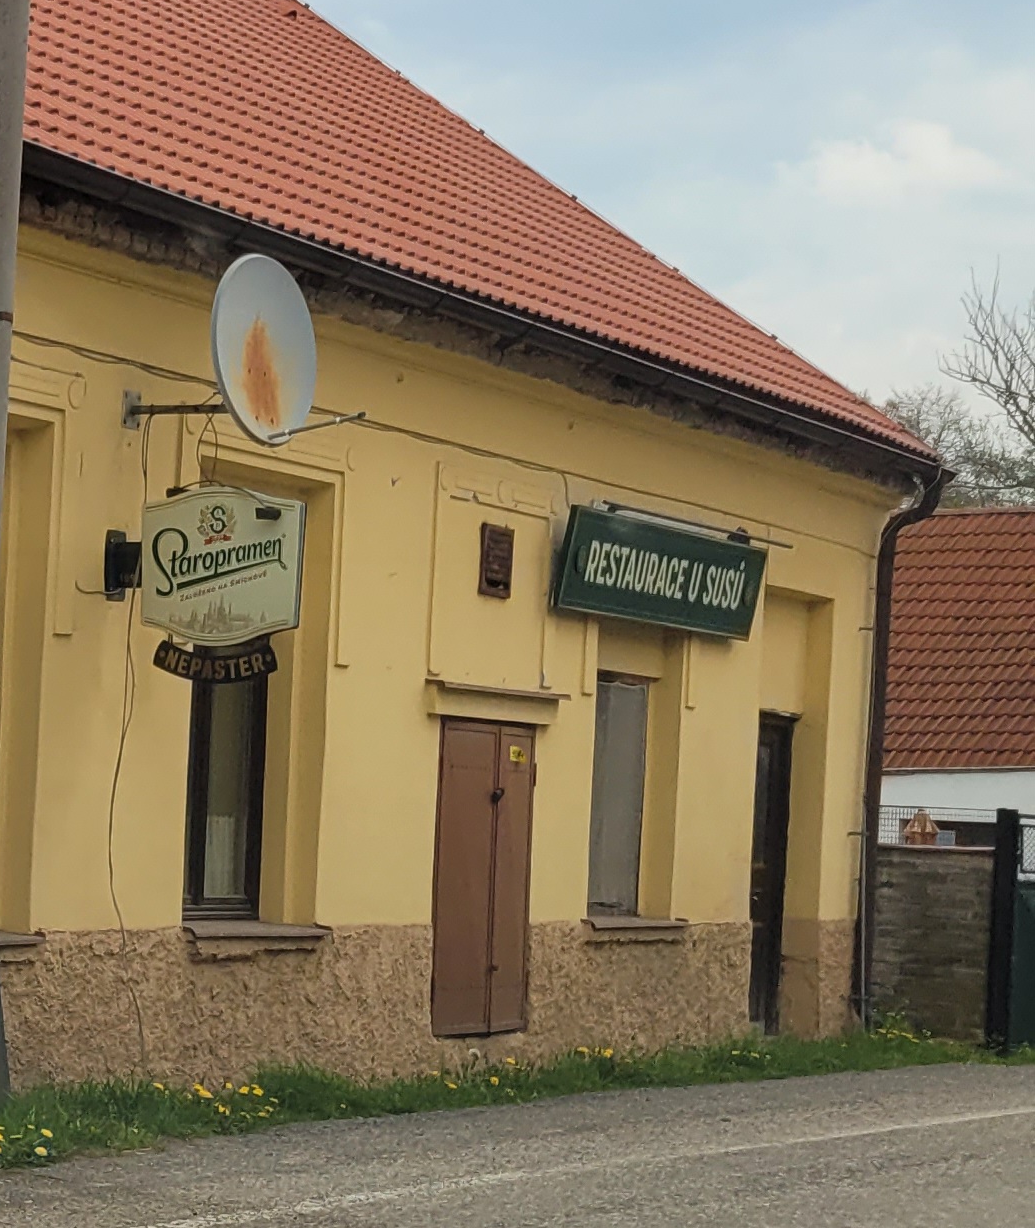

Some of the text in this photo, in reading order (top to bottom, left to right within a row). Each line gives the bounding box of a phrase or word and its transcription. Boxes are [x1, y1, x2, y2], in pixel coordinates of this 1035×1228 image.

[152, 527, 289, 598] Staropramen
[584, 540, 689, 600] RESTAURACE
[688, 561, 704, 603] U
[164, 648, 266, 680] NEPASTER
